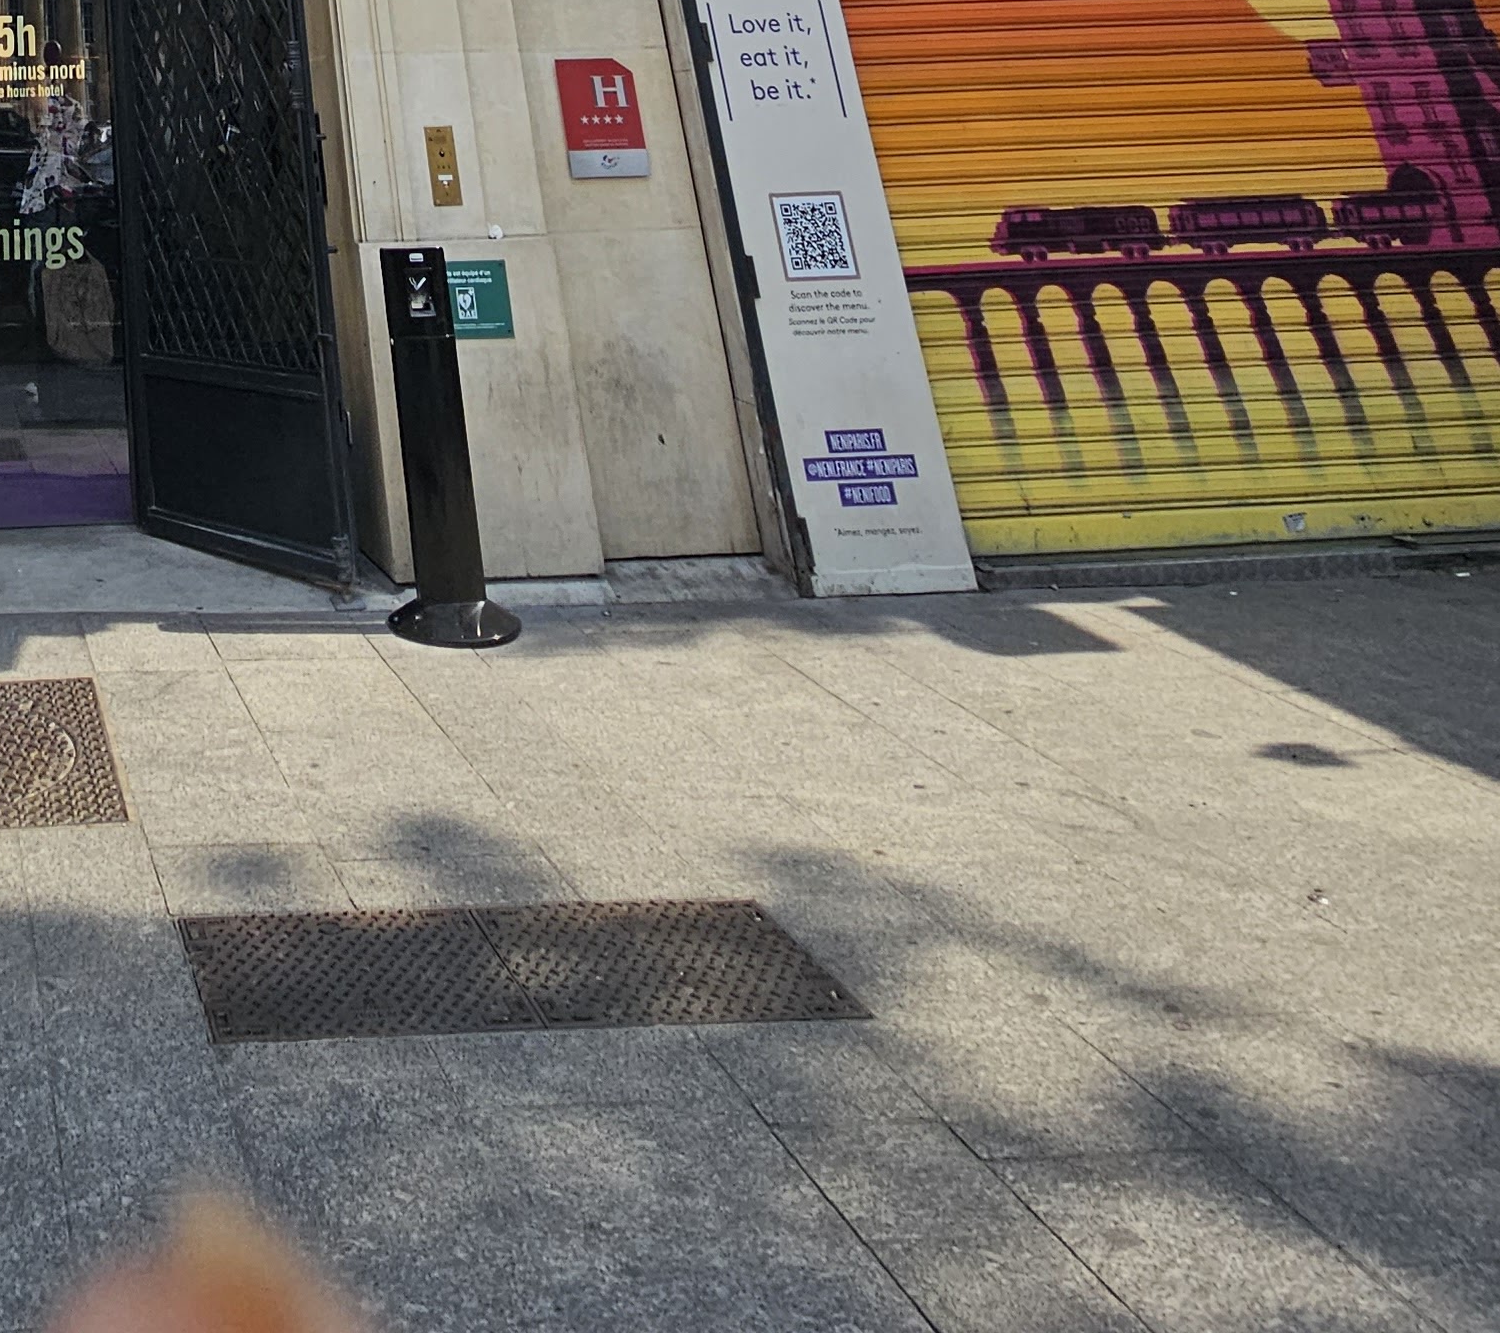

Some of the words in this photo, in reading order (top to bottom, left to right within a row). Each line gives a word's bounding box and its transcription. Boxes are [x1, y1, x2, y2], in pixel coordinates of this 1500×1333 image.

[728, 13, 780, 33] Love
[786, 12, 811, 35] it,
[740, 48, 779, 67] eat
[783, 45, 808, 69] it,
[49, 59, 86, 81] nord
[6, 84, 35, 99] hours
[38, 83, 64, 98] hotel
[589, 74, 630, 108] H
[750, 79, 779, 100] be
[790, 290, 813, 300] Scan
[813, 289, 829, 299] the
[830, 288, 852, 299] code
[852, 289, 863, 298] to
[788, 302, 824, 313] discover
[825, 302, 841, 311] the
